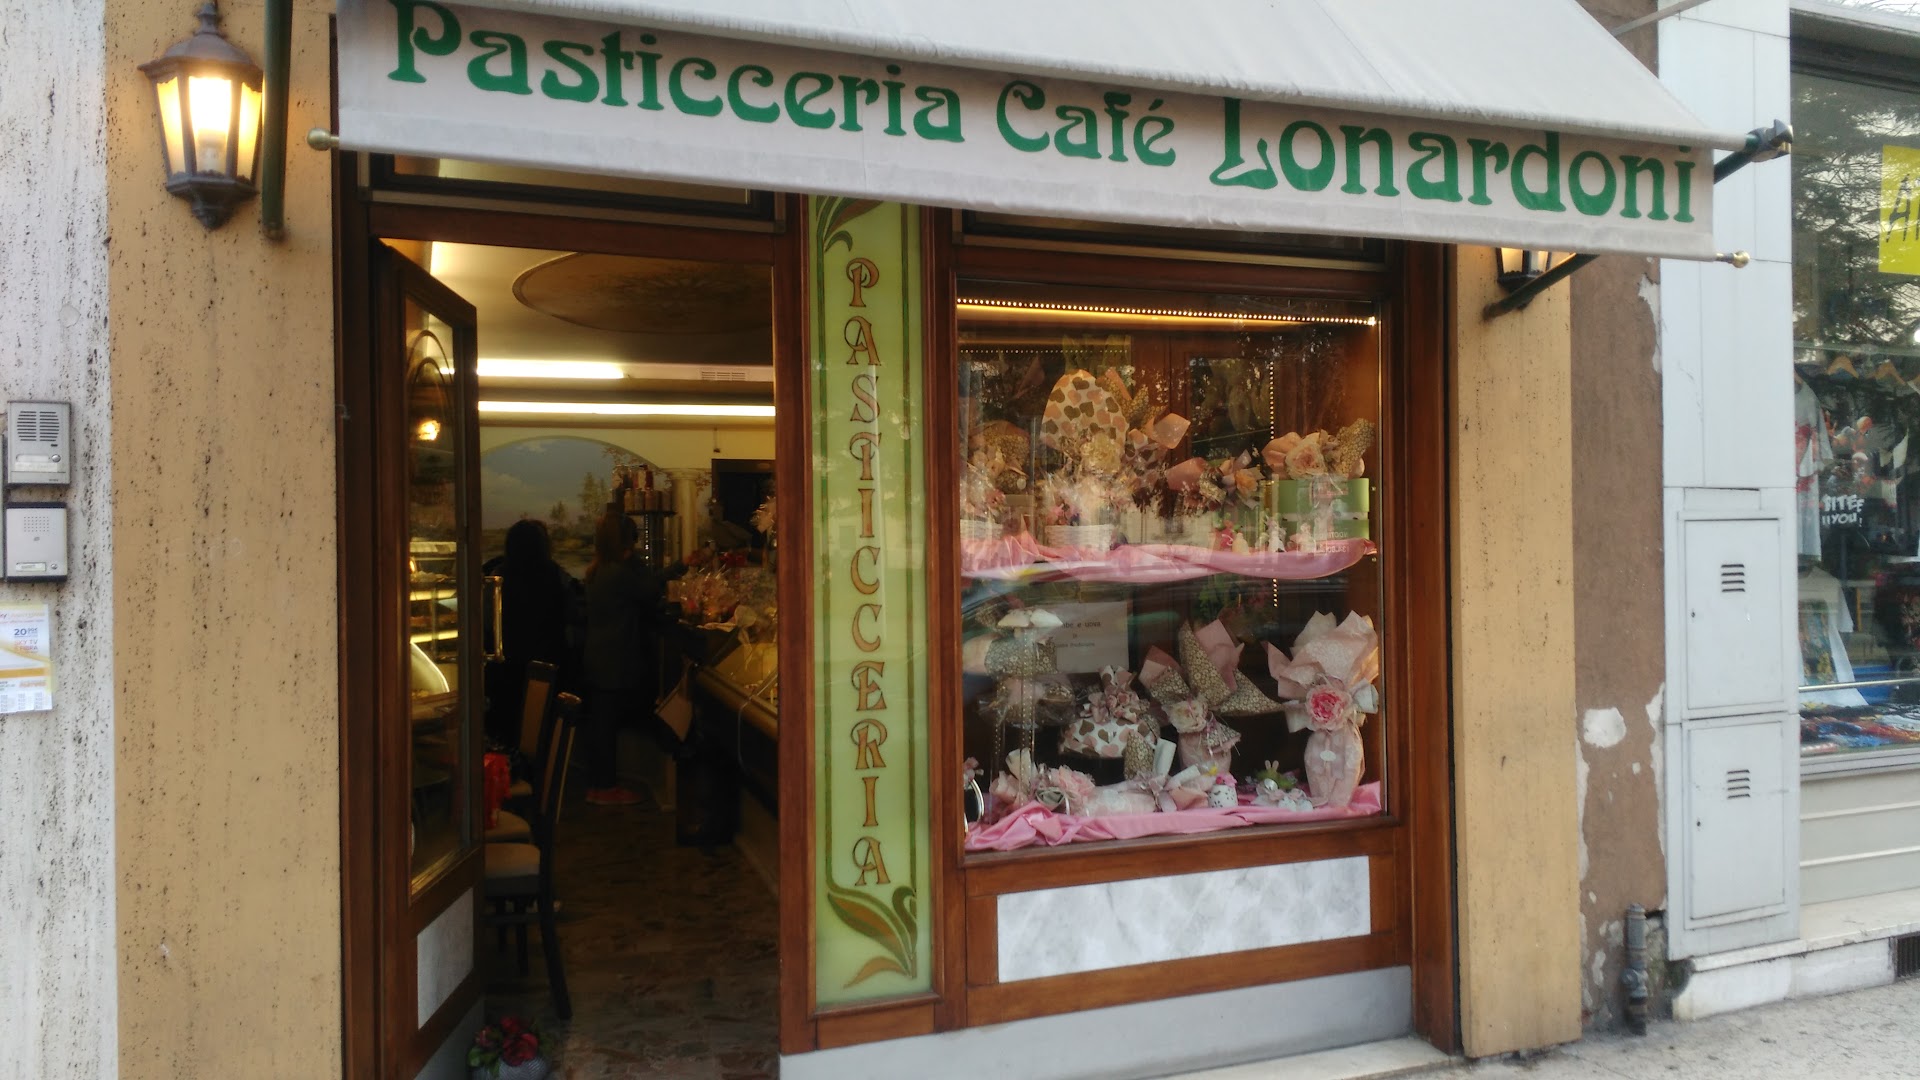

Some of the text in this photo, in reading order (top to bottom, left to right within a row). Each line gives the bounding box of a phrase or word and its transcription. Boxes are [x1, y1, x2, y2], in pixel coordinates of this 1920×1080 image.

[387, 0, 1696, 224] Pasticceria Café Lonardoni
[844, 257, 891, 887] PASTICCERIA
